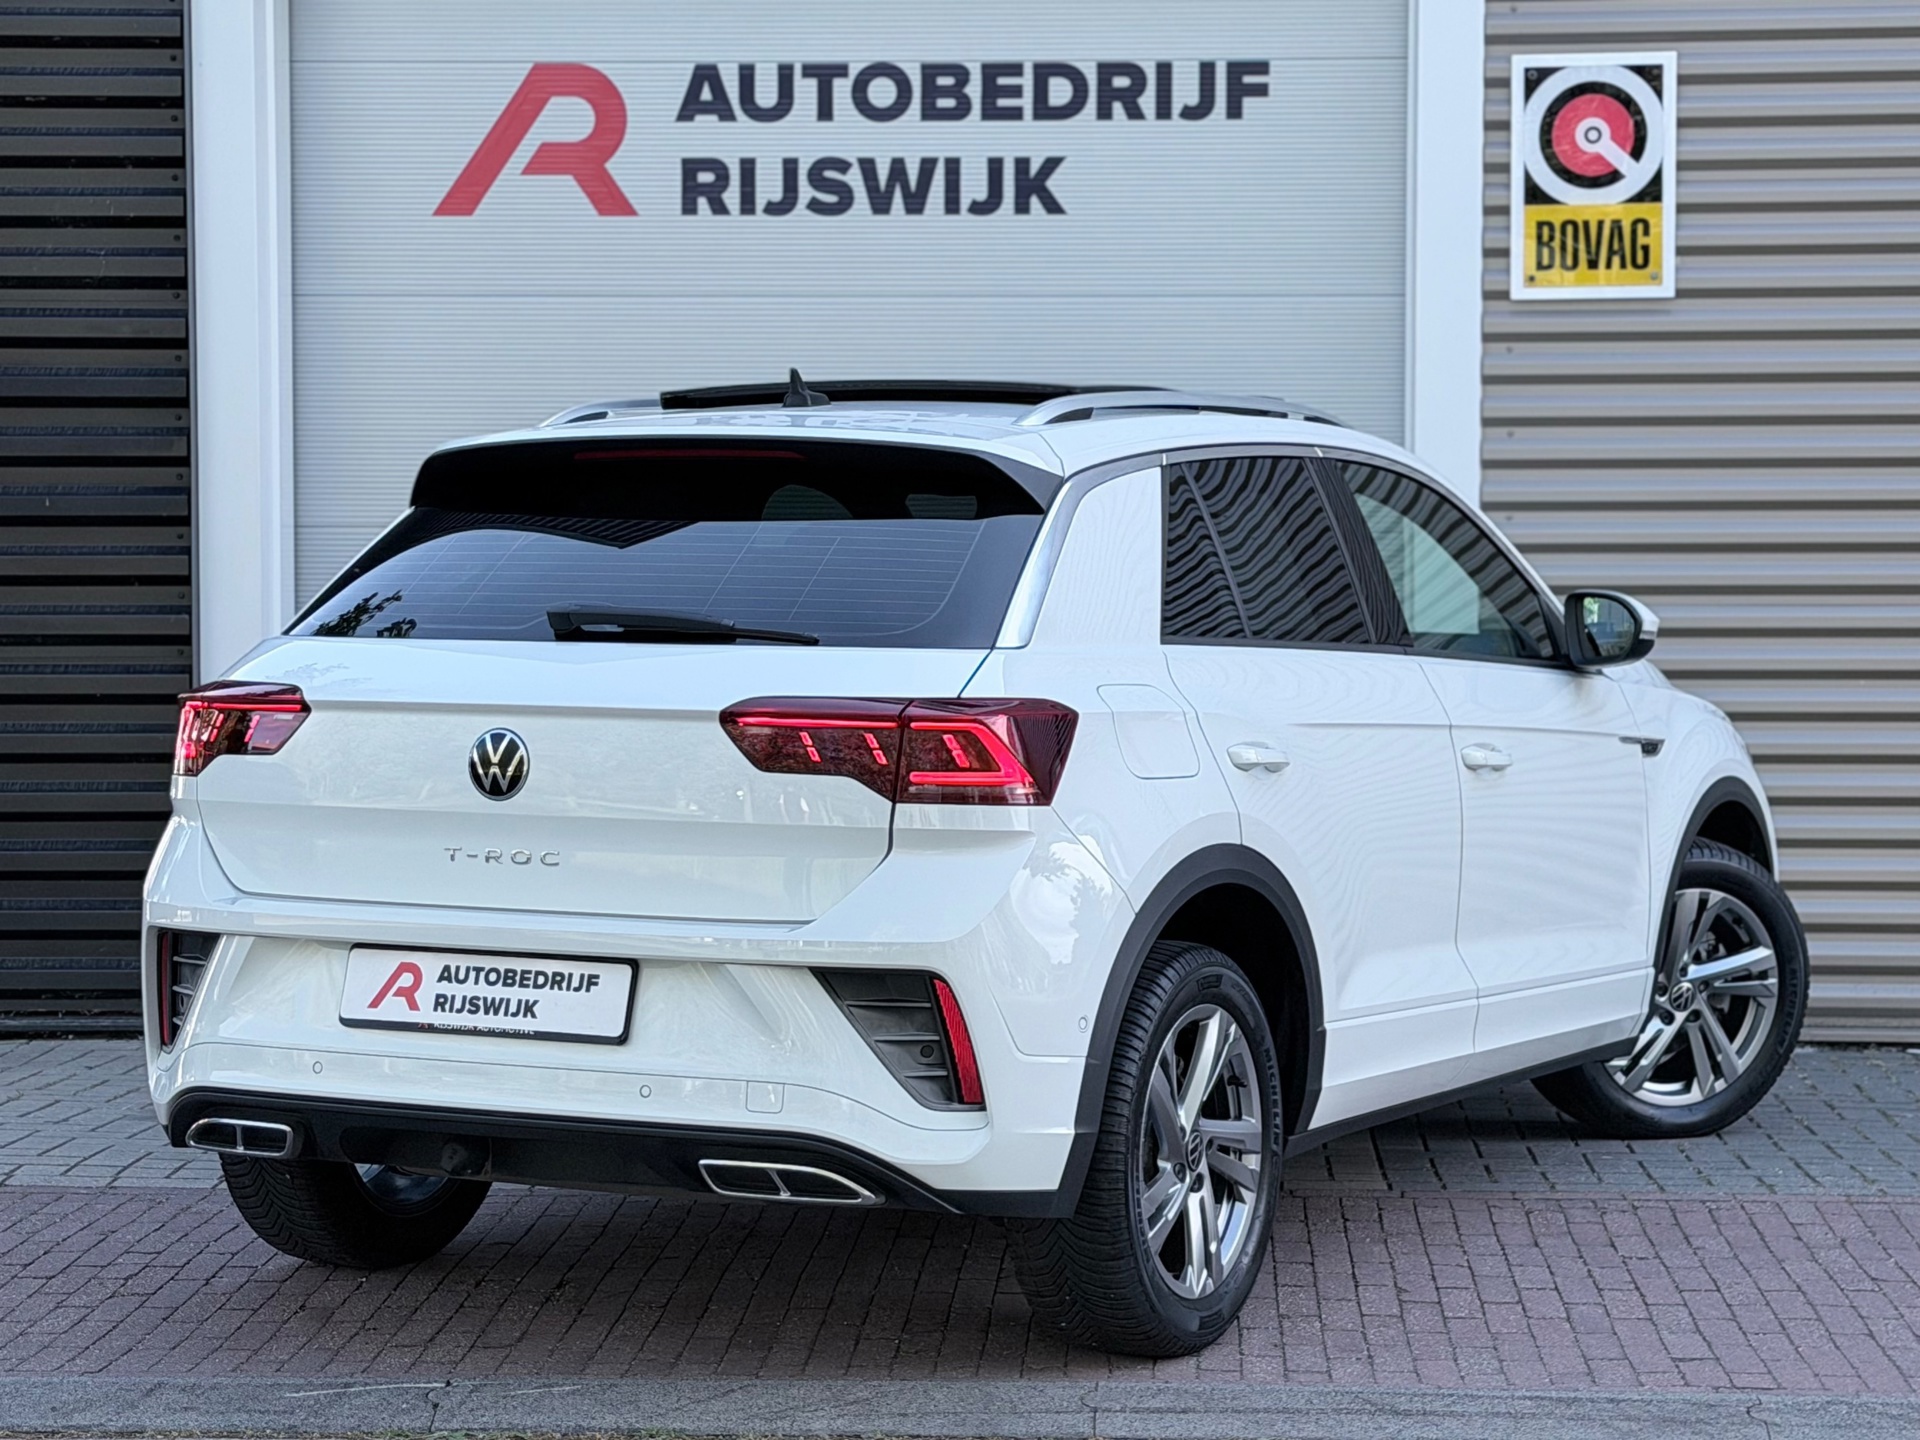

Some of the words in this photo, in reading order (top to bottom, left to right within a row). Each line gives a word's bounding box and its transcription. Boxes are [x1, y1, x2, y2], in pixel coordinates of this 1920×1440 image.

[675, 60, 1271, 122] AUTOBEDRIJF
[680, 157, 1067, 217] RIJSWIJK
[1535, 218, 1650, 272] BOVAG
[444, 846, 560, 867] T-ROC
[436, 964, 601, 993] AUTOBEDRIJF
[432, 993, 540, 1019] RIJSWIJK
[1263, 1047, 1281, 1147] MICHELIN
